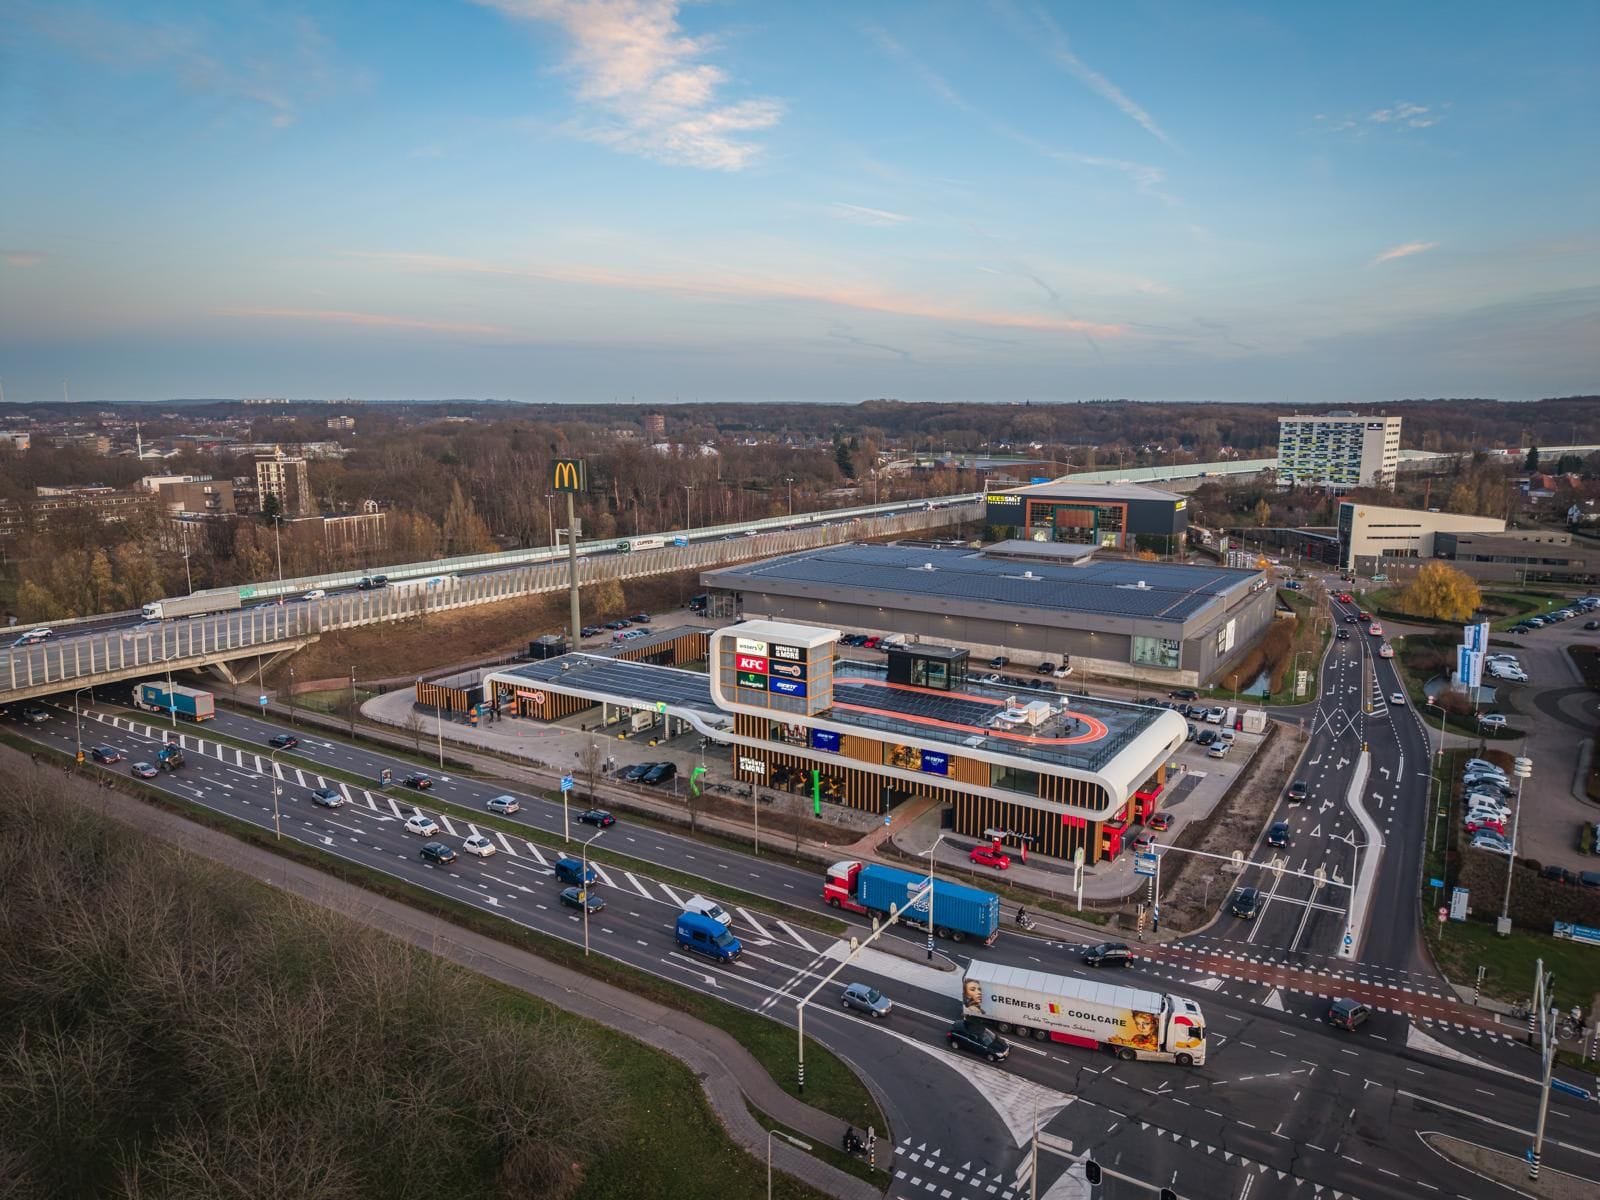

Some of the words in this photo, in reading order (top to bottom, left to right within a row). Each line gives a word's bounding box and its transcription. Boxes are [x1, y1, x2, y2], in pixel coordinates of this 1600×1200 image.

[740, 657, 764, 671] KFC
[991, 994, 1041, 1011] CREMERS
[1068, 1010, 1127, 1027] COOLCARE
